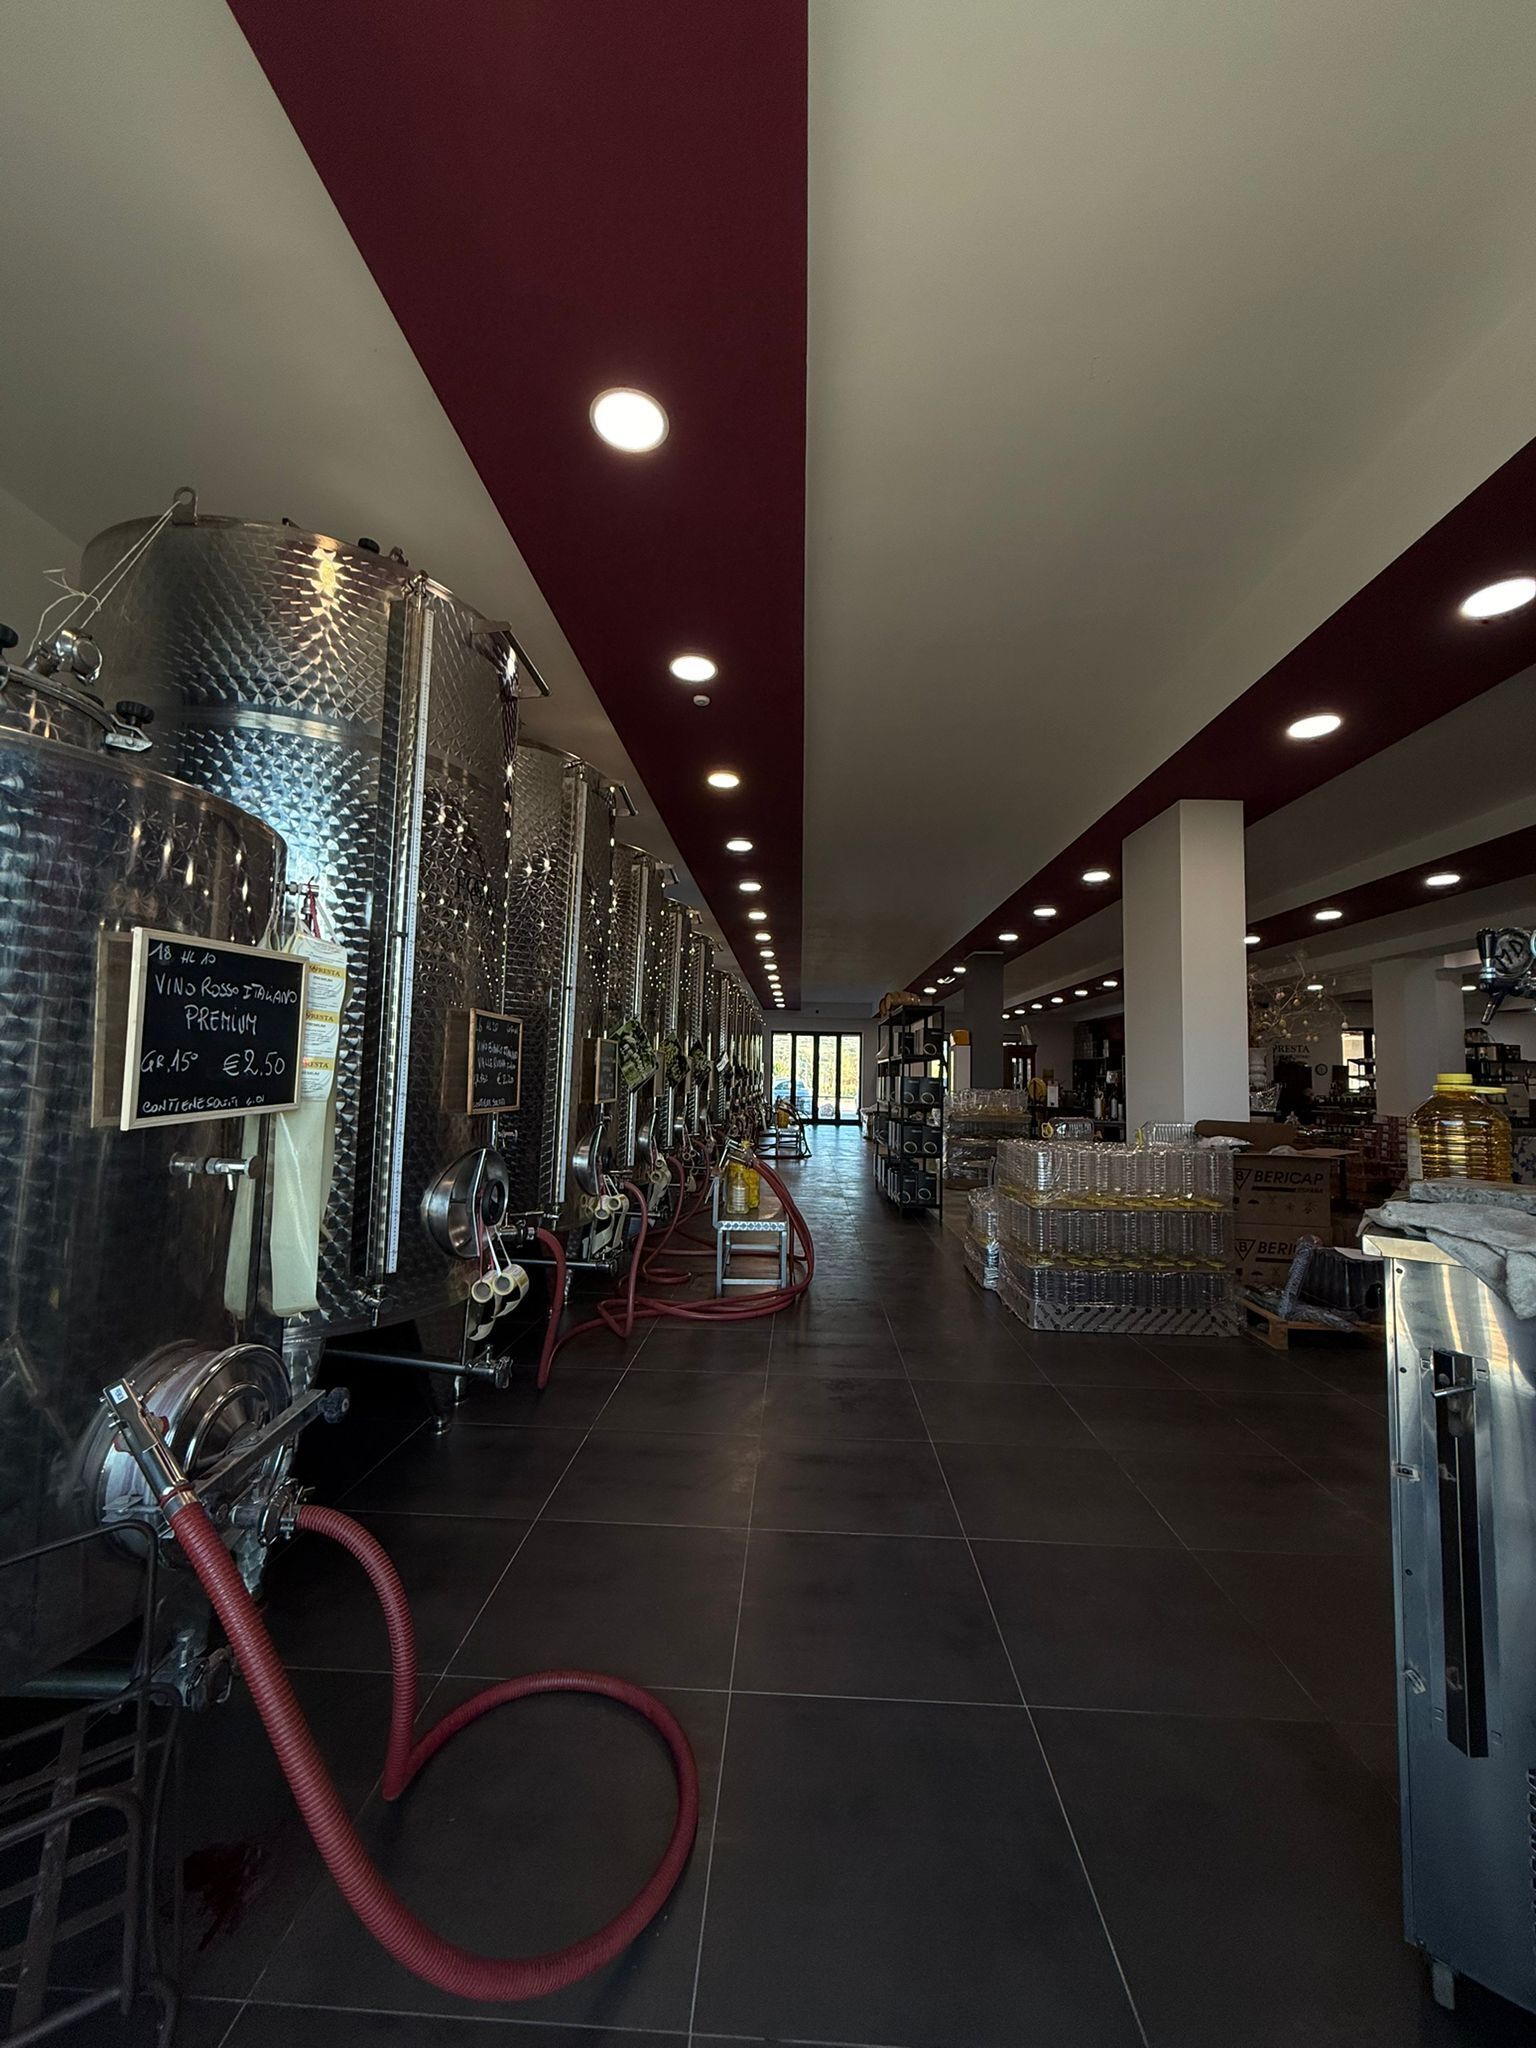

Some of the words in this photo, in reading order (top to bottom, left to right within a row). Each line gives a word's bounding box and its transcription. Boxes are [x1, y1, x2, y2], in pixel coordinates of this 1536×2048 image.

[149, 943, 172, 960] 18
[155, 972, 196, 996] VINO
[201, 976, 239, 998] ROSSO
[243, 983, 298, 1005] ITALIANO
[184, 1004, 257, 1036] PREMIUM
[142, 1096, 205, 1113] CONTIENE
[1254, 1170, 1324, 1185] BERICAP
